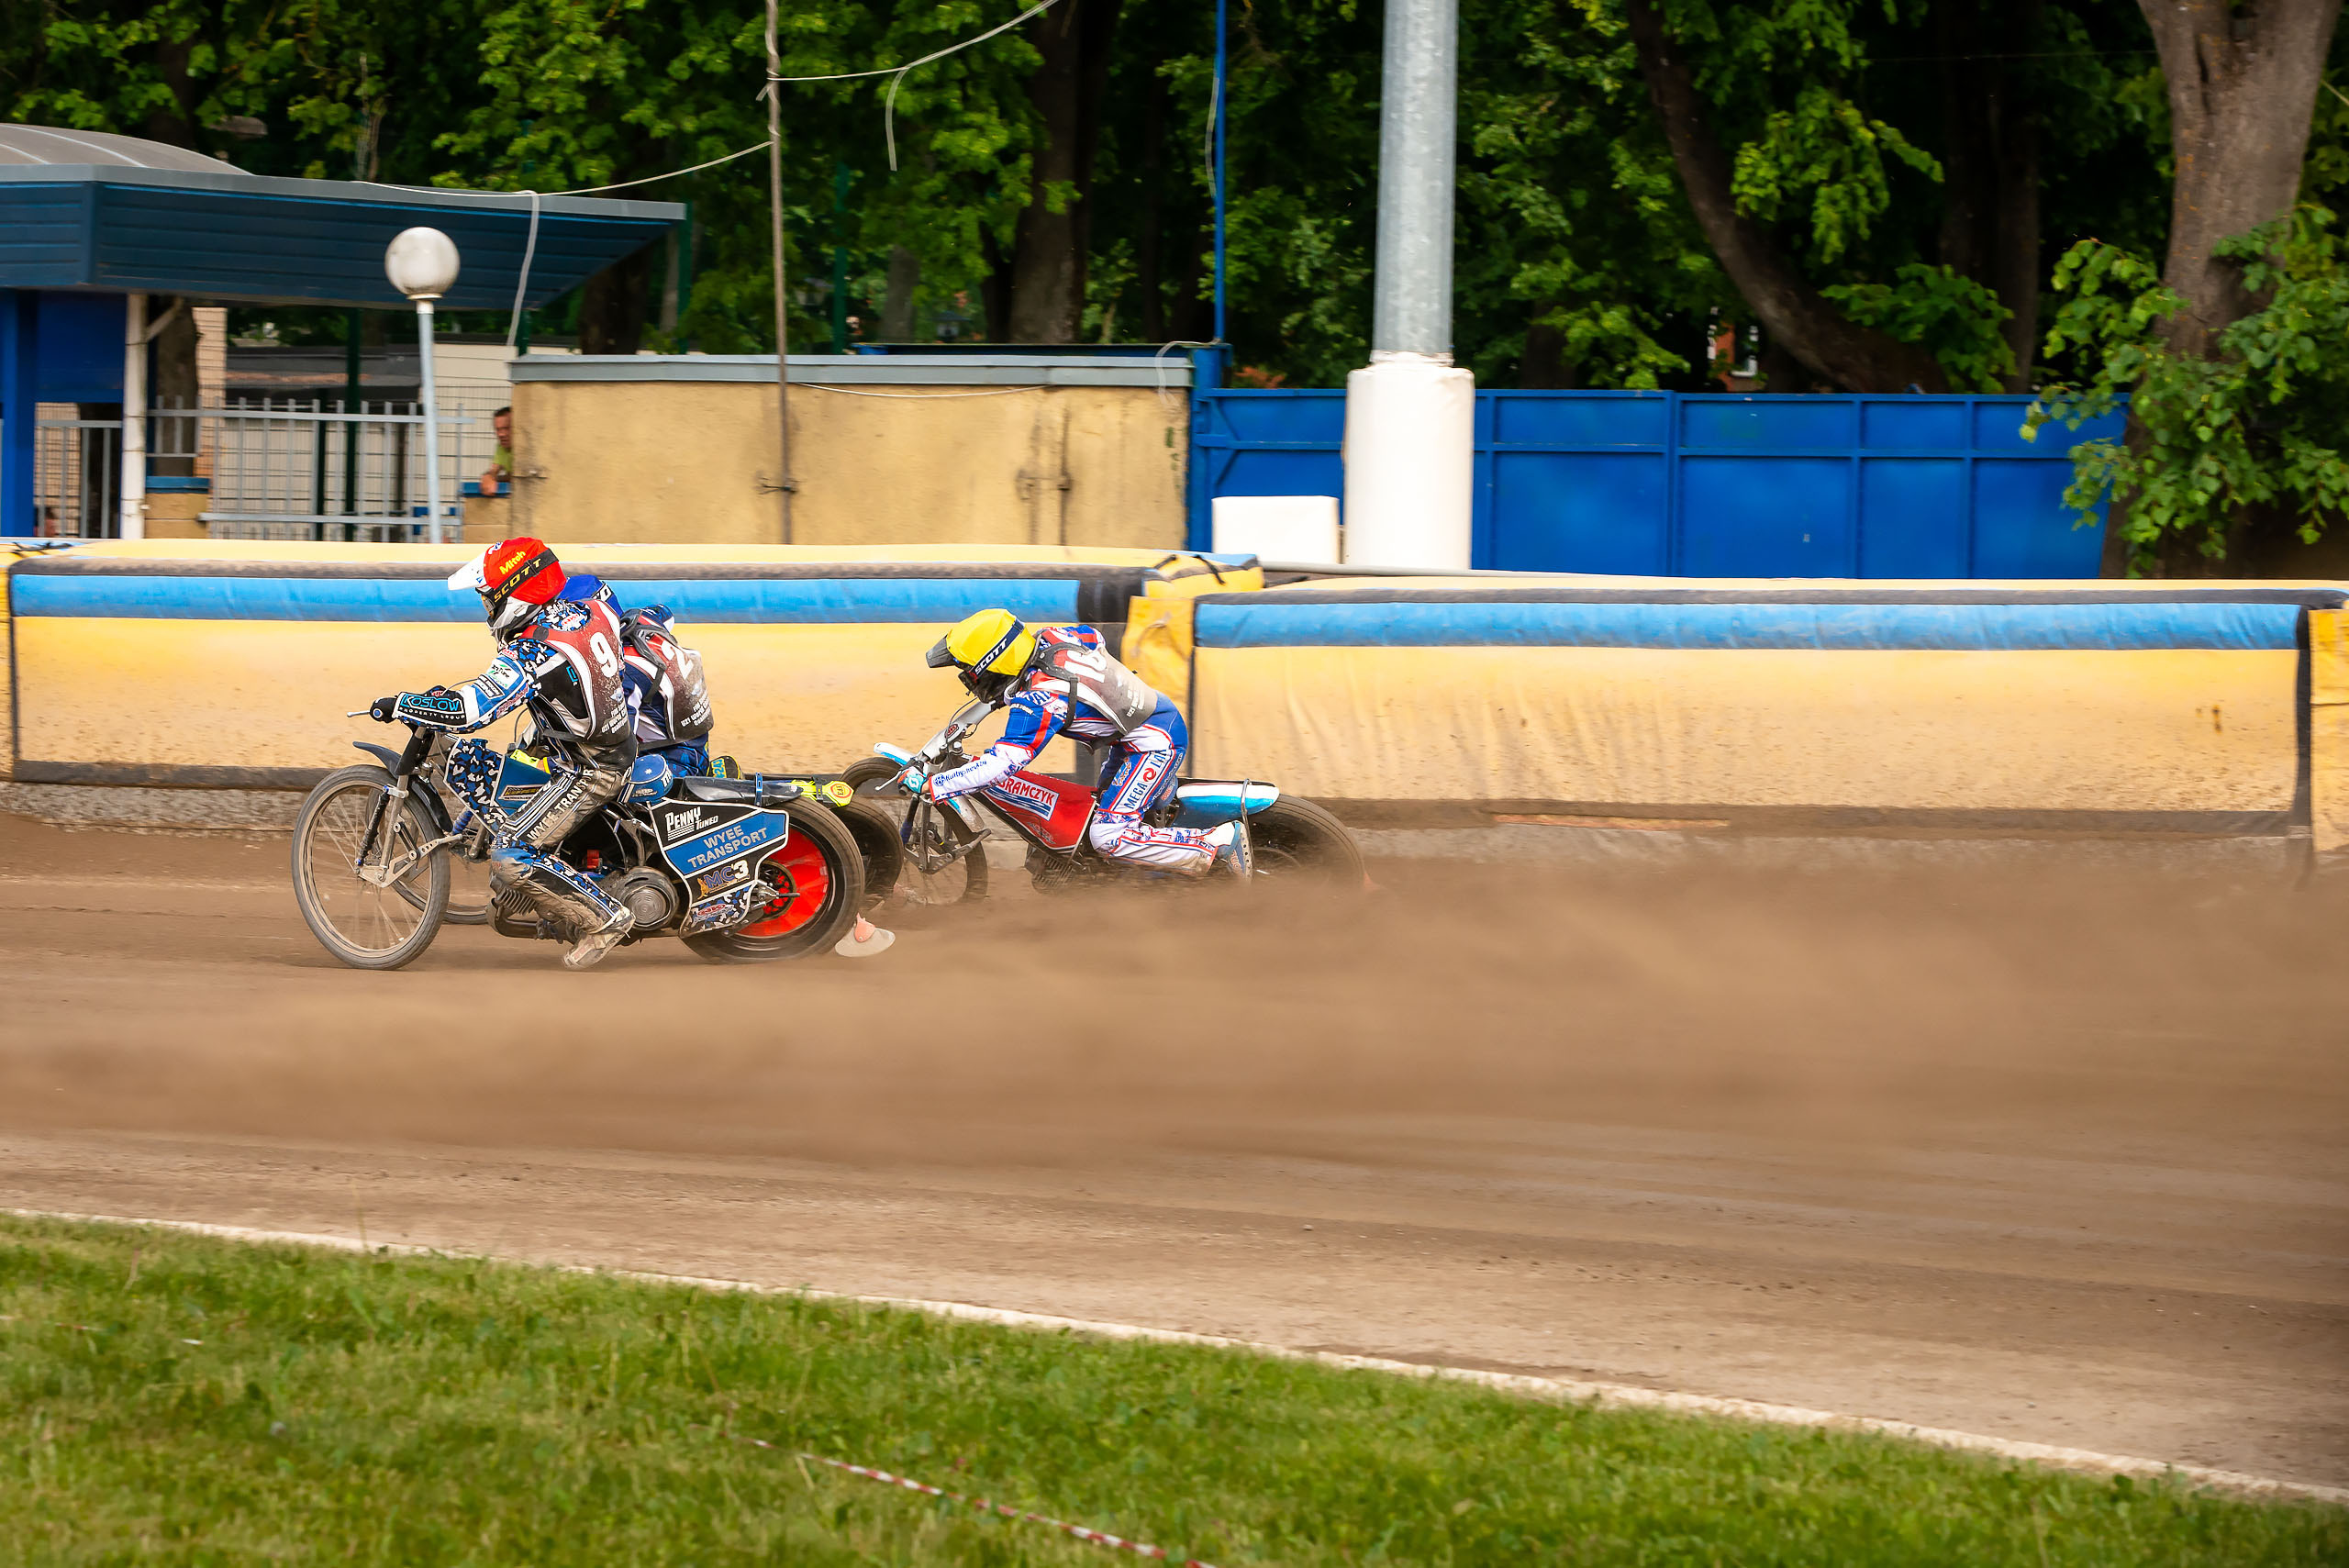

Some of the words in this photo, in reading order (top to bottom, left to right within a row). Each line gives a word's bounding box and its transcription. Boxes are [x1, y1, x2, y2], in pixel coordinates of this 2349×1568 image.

[494, 558, 541, 603] SCOTT
[590, 631, 618, 677] 9
[661, 640, 694, 680] 2
[974, 638, 1008, 675] SCOTT
[400, 694, 460, 711] KOSLOW
[554, 769, 595, 813] TRANSPOR
[1124, 782, 1148, 809] MEGA
[687, 828, 767, 868] TRANSPORT
[703, 825, 744, 849] WYEE
